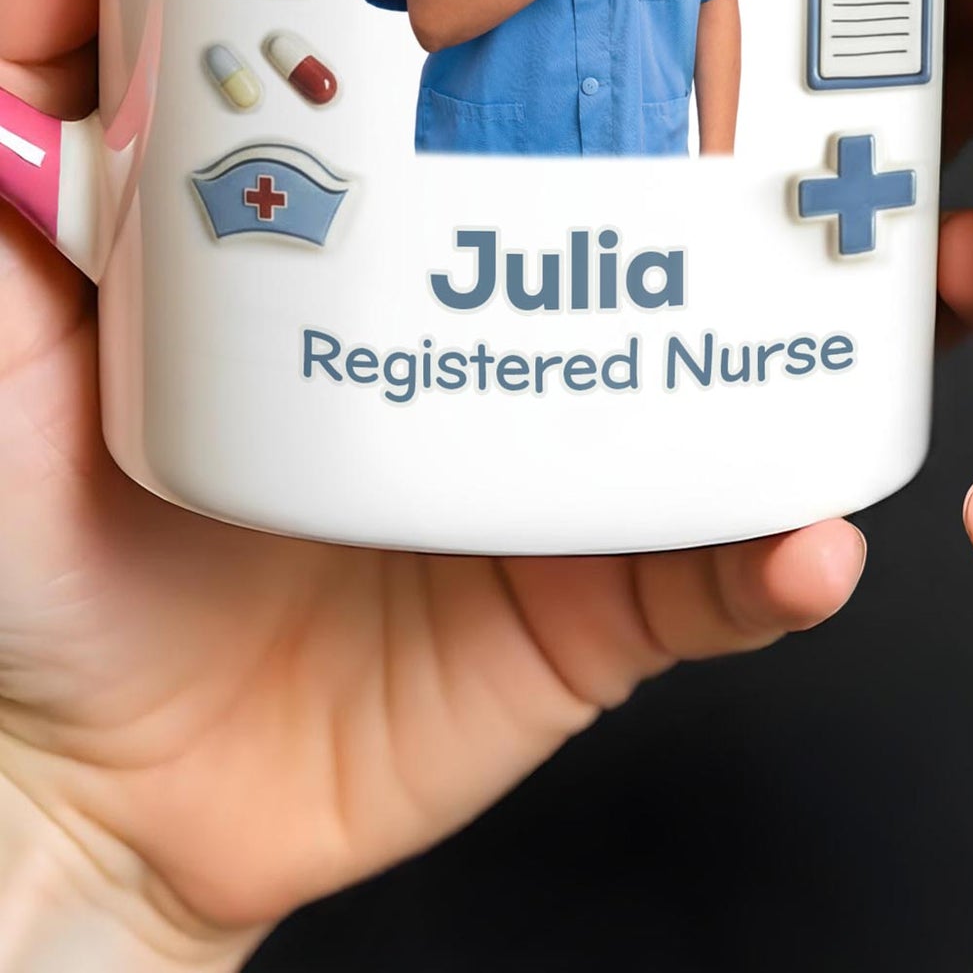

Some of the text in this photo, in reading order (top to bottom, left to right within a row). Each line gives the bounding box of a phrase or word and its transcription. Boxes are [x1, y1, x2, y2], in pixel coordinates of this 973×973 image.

[430, 230, 684, 311] Julia
[303, 329, 853, 403] Registered Nurse
